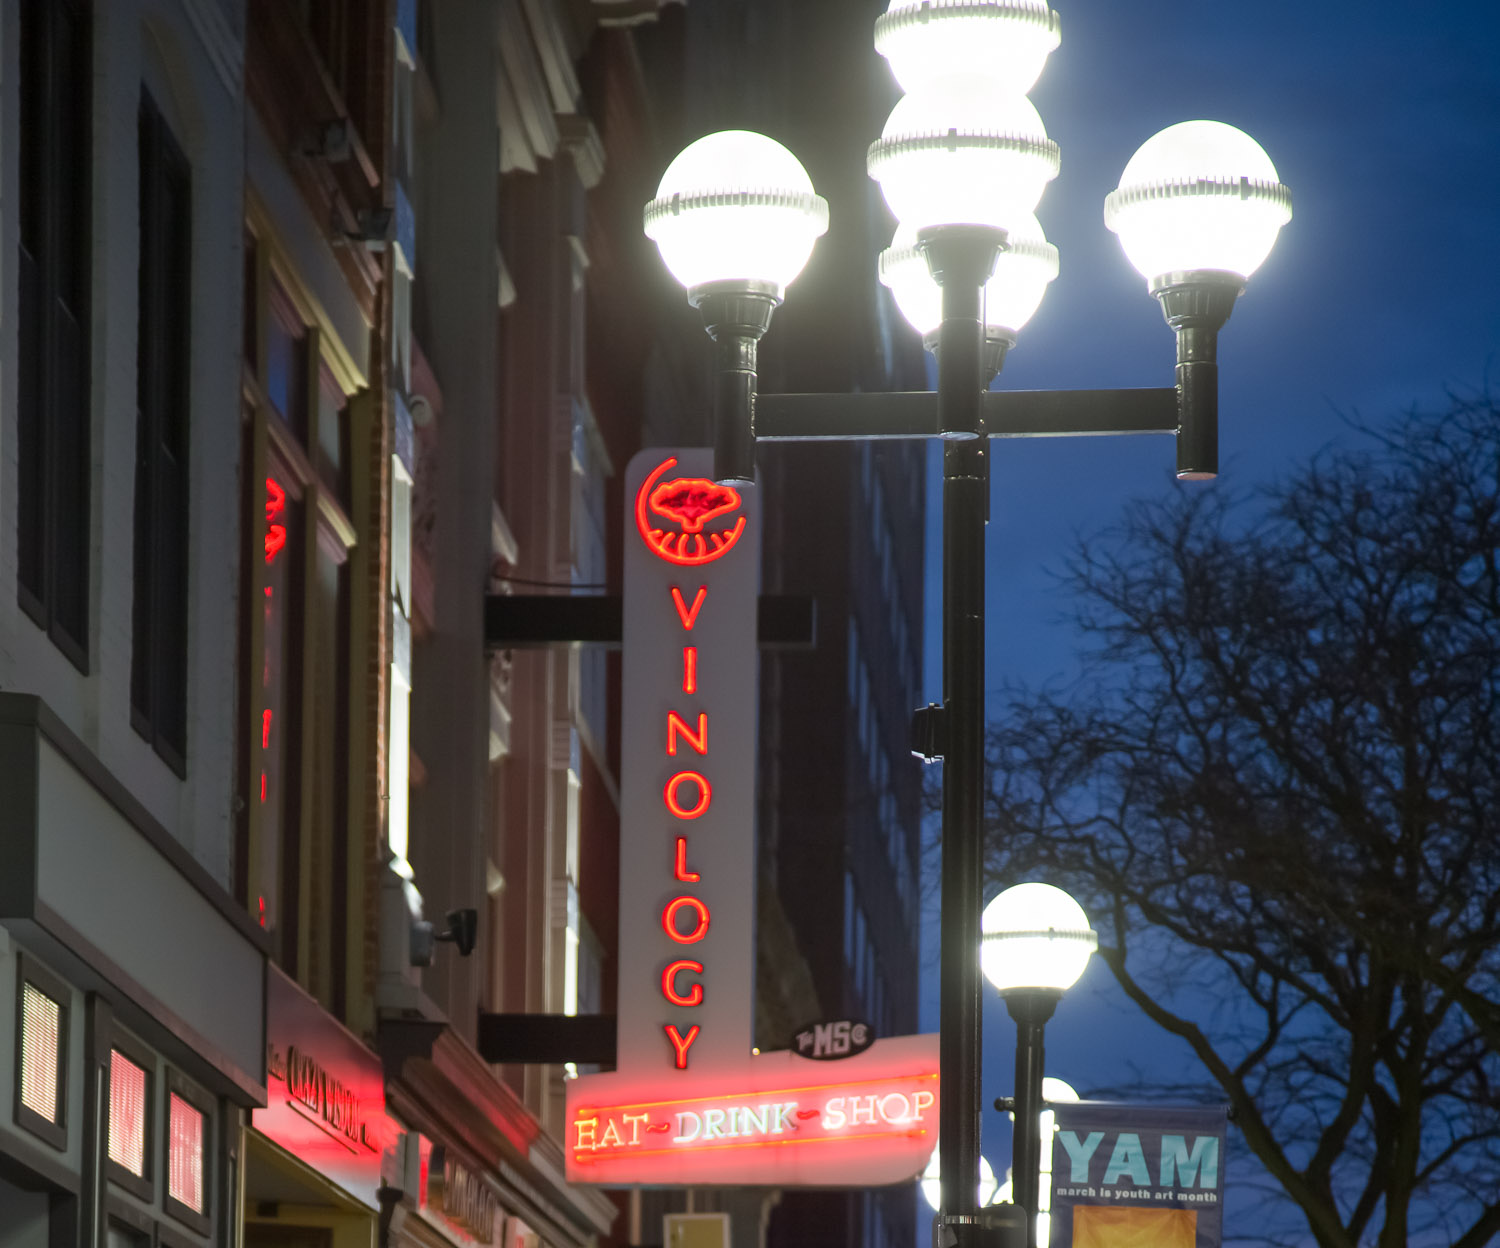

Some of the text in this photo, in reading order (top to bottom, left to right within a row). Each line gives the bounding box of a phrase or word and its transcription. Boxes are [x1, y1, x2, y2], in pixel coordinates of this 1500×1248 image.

[662, 584, 712, 1070] VINOLOGY
[573, 1090, 935, 1150] EAT DRINK SHOP
[1058, 1130, 1219, 1189] YAM
[1057, 1187, 1217, 1202] march is youth art month
